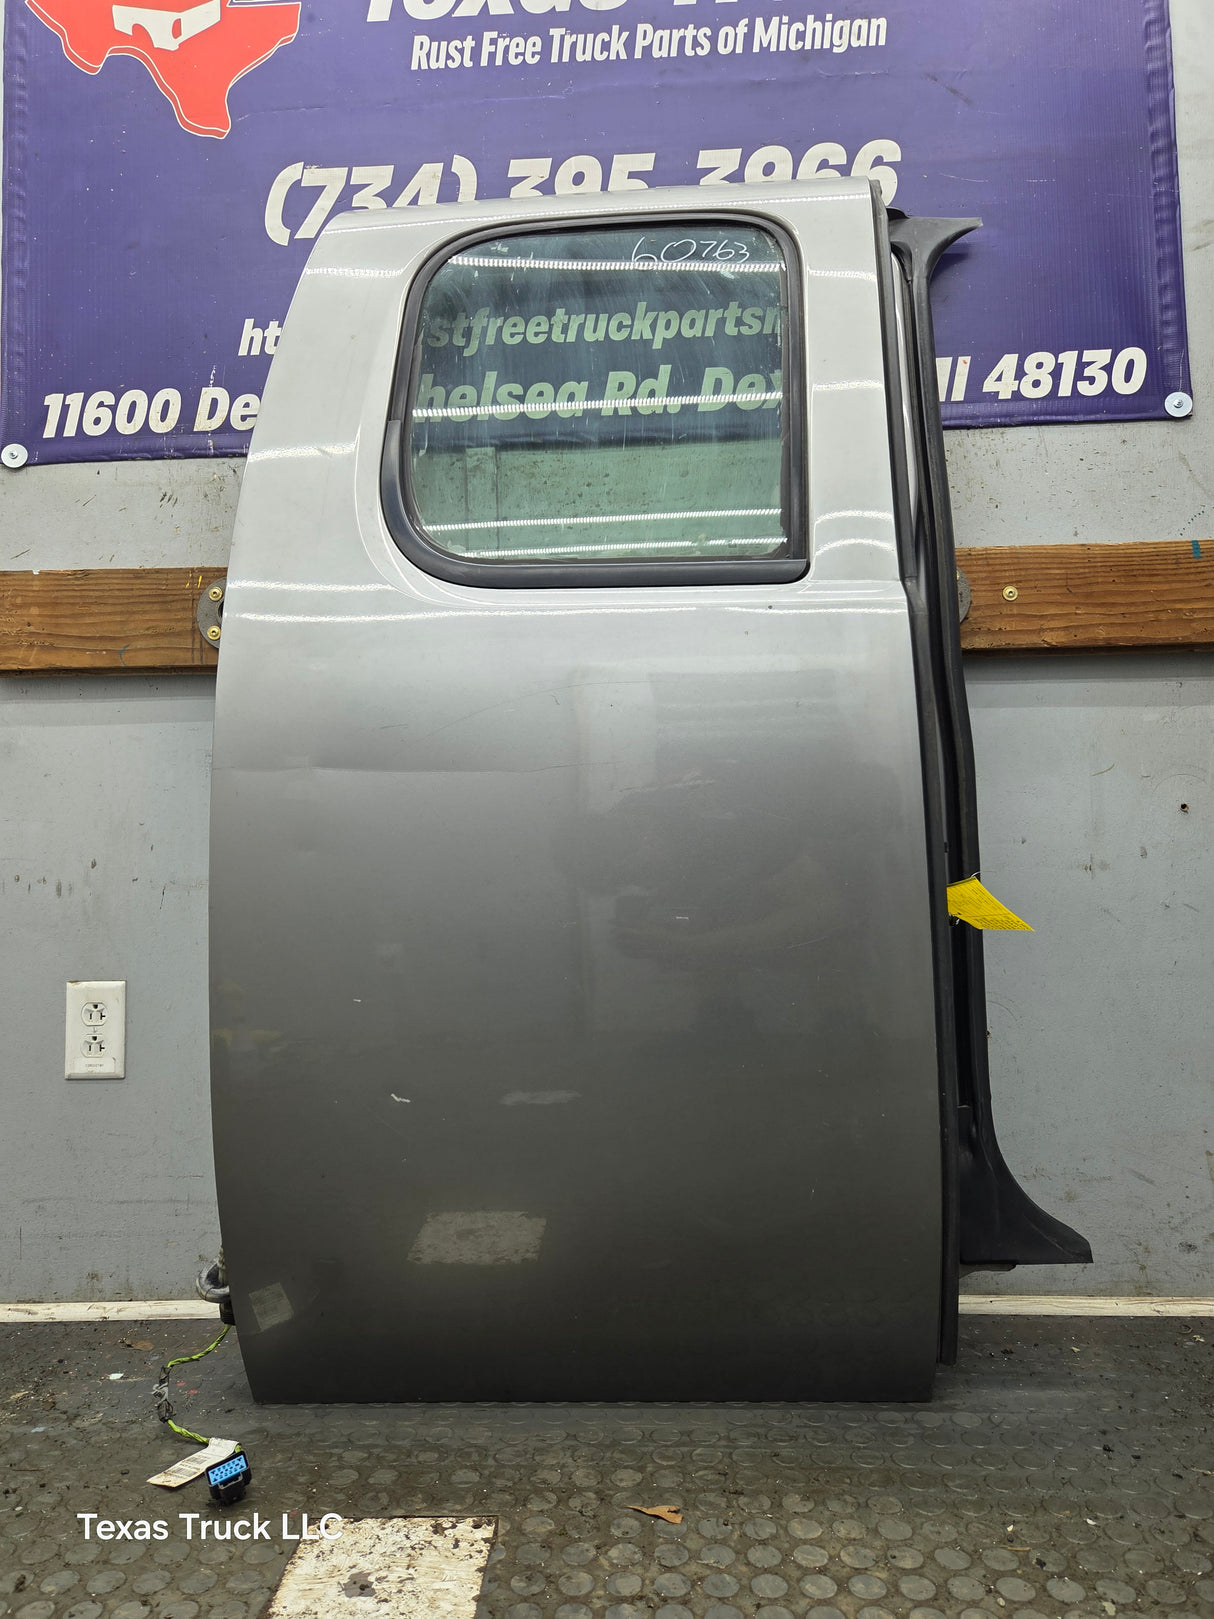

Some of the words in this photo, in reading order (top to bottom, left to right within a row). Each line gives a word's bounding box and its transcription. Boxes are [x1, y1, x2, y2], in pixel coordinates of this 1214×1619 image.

[411, 34, 475, 70] Rust
[480, 31, 542, 66] Free
[549, 24, 630, 63] Truck
[634, 23, 711, 59] Parts
[717, 18, 749, 54] of
[752, 13, 888, 54] Michigan
[631, 236, 750, 270] 60763
[42, 388, 182, 439] 11600
[193, 386, 261, 431] De
[601, 365, 681, 416] Rd.
[982, 346, 1148, 400] 48130
